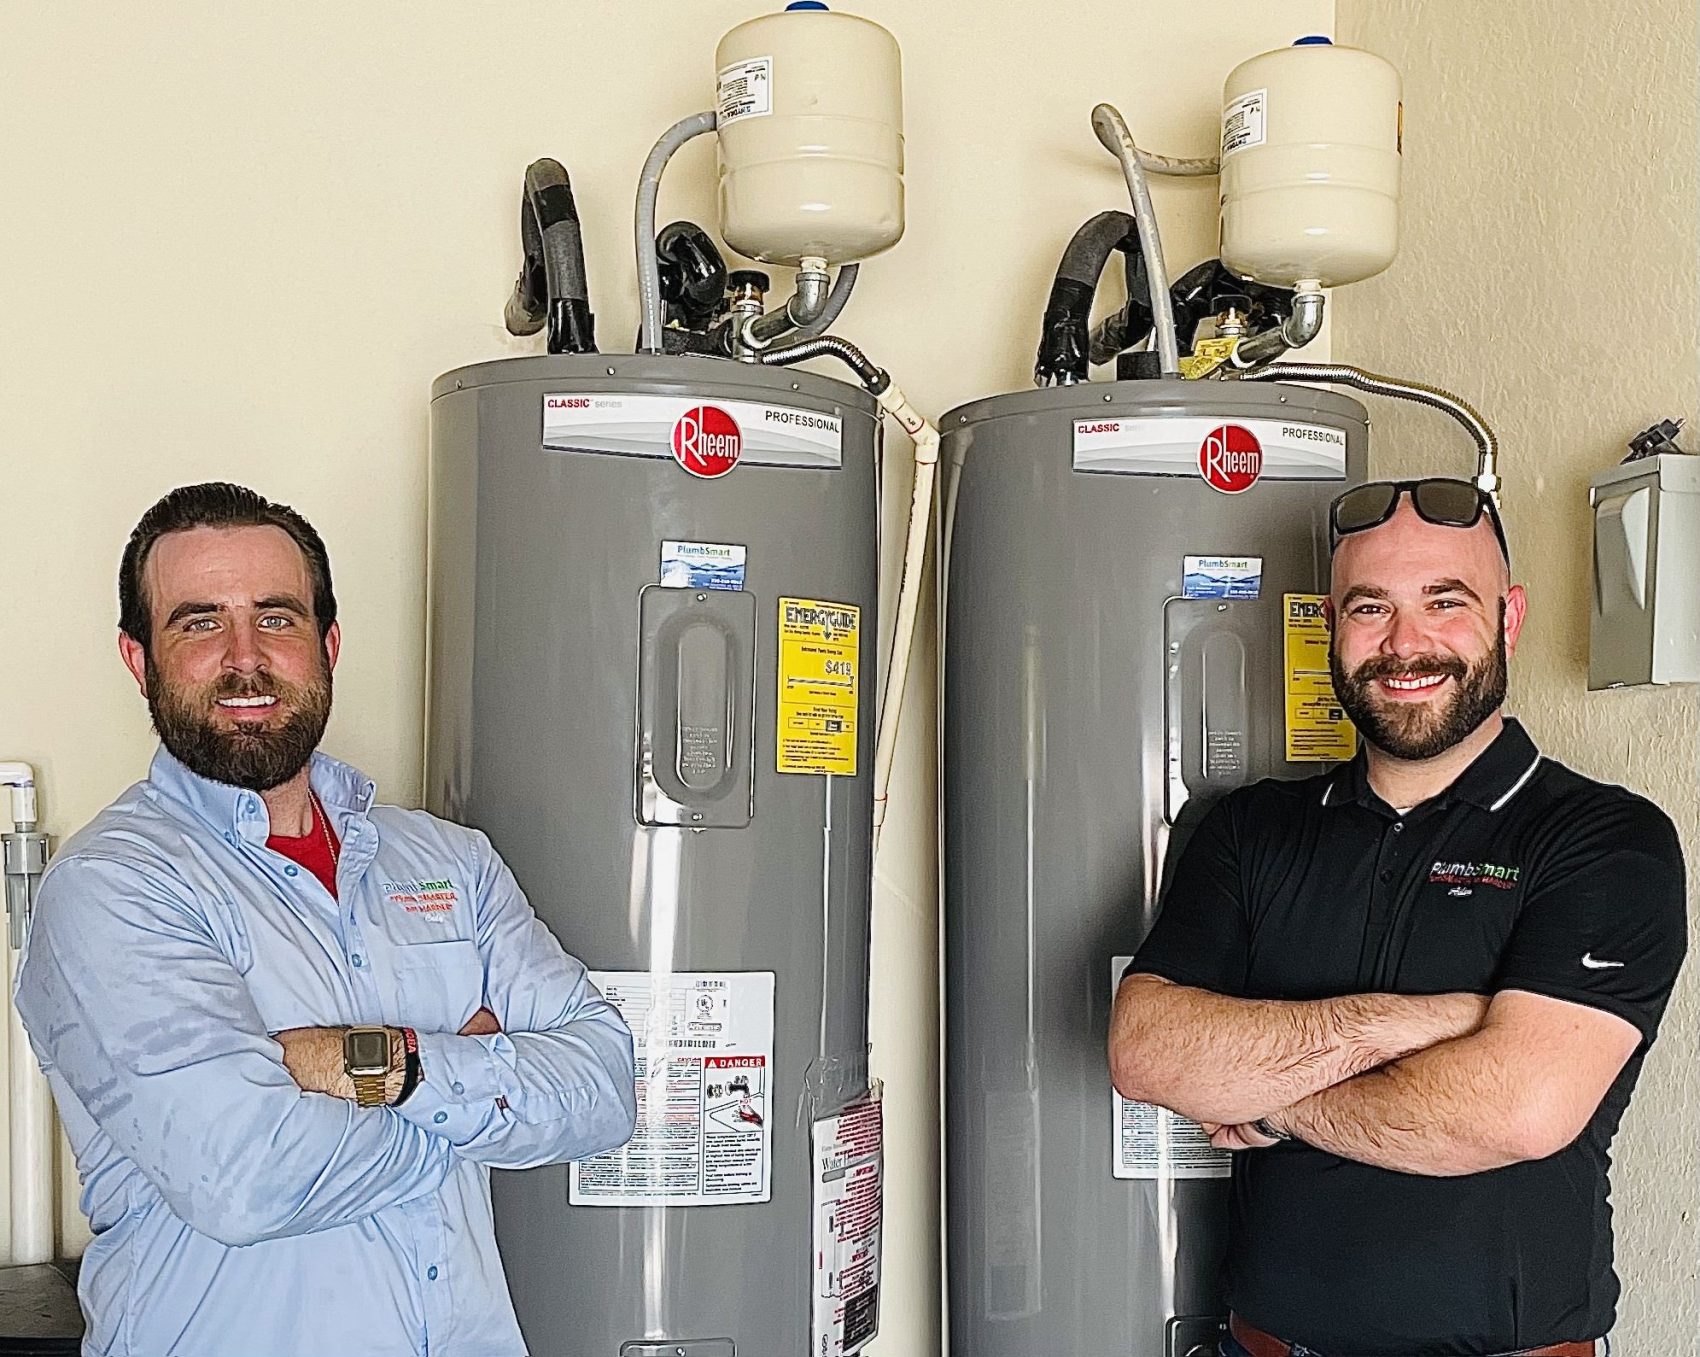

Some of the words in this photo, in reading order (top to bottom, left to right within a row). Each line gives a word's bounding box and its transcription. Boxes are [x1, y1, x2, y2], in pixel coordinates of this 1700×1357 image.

[547, 398, 590, 408] CLASSIC
[765, 410, 840, 433] PROFESSIONAL
[1077, 423, 1120, 434] CLASSIC
[680, 406, 739, 467] Rheem
[1282, 427, 1344, 446] PROFESSIONAL
[1206, 425, 1260, 483] Rheem
[677, 545, 731, 556] PlumbSmart
[1198, 559, 1248, 568] PlumbSmart
[720, 1058, 762, 1068] DANGER
